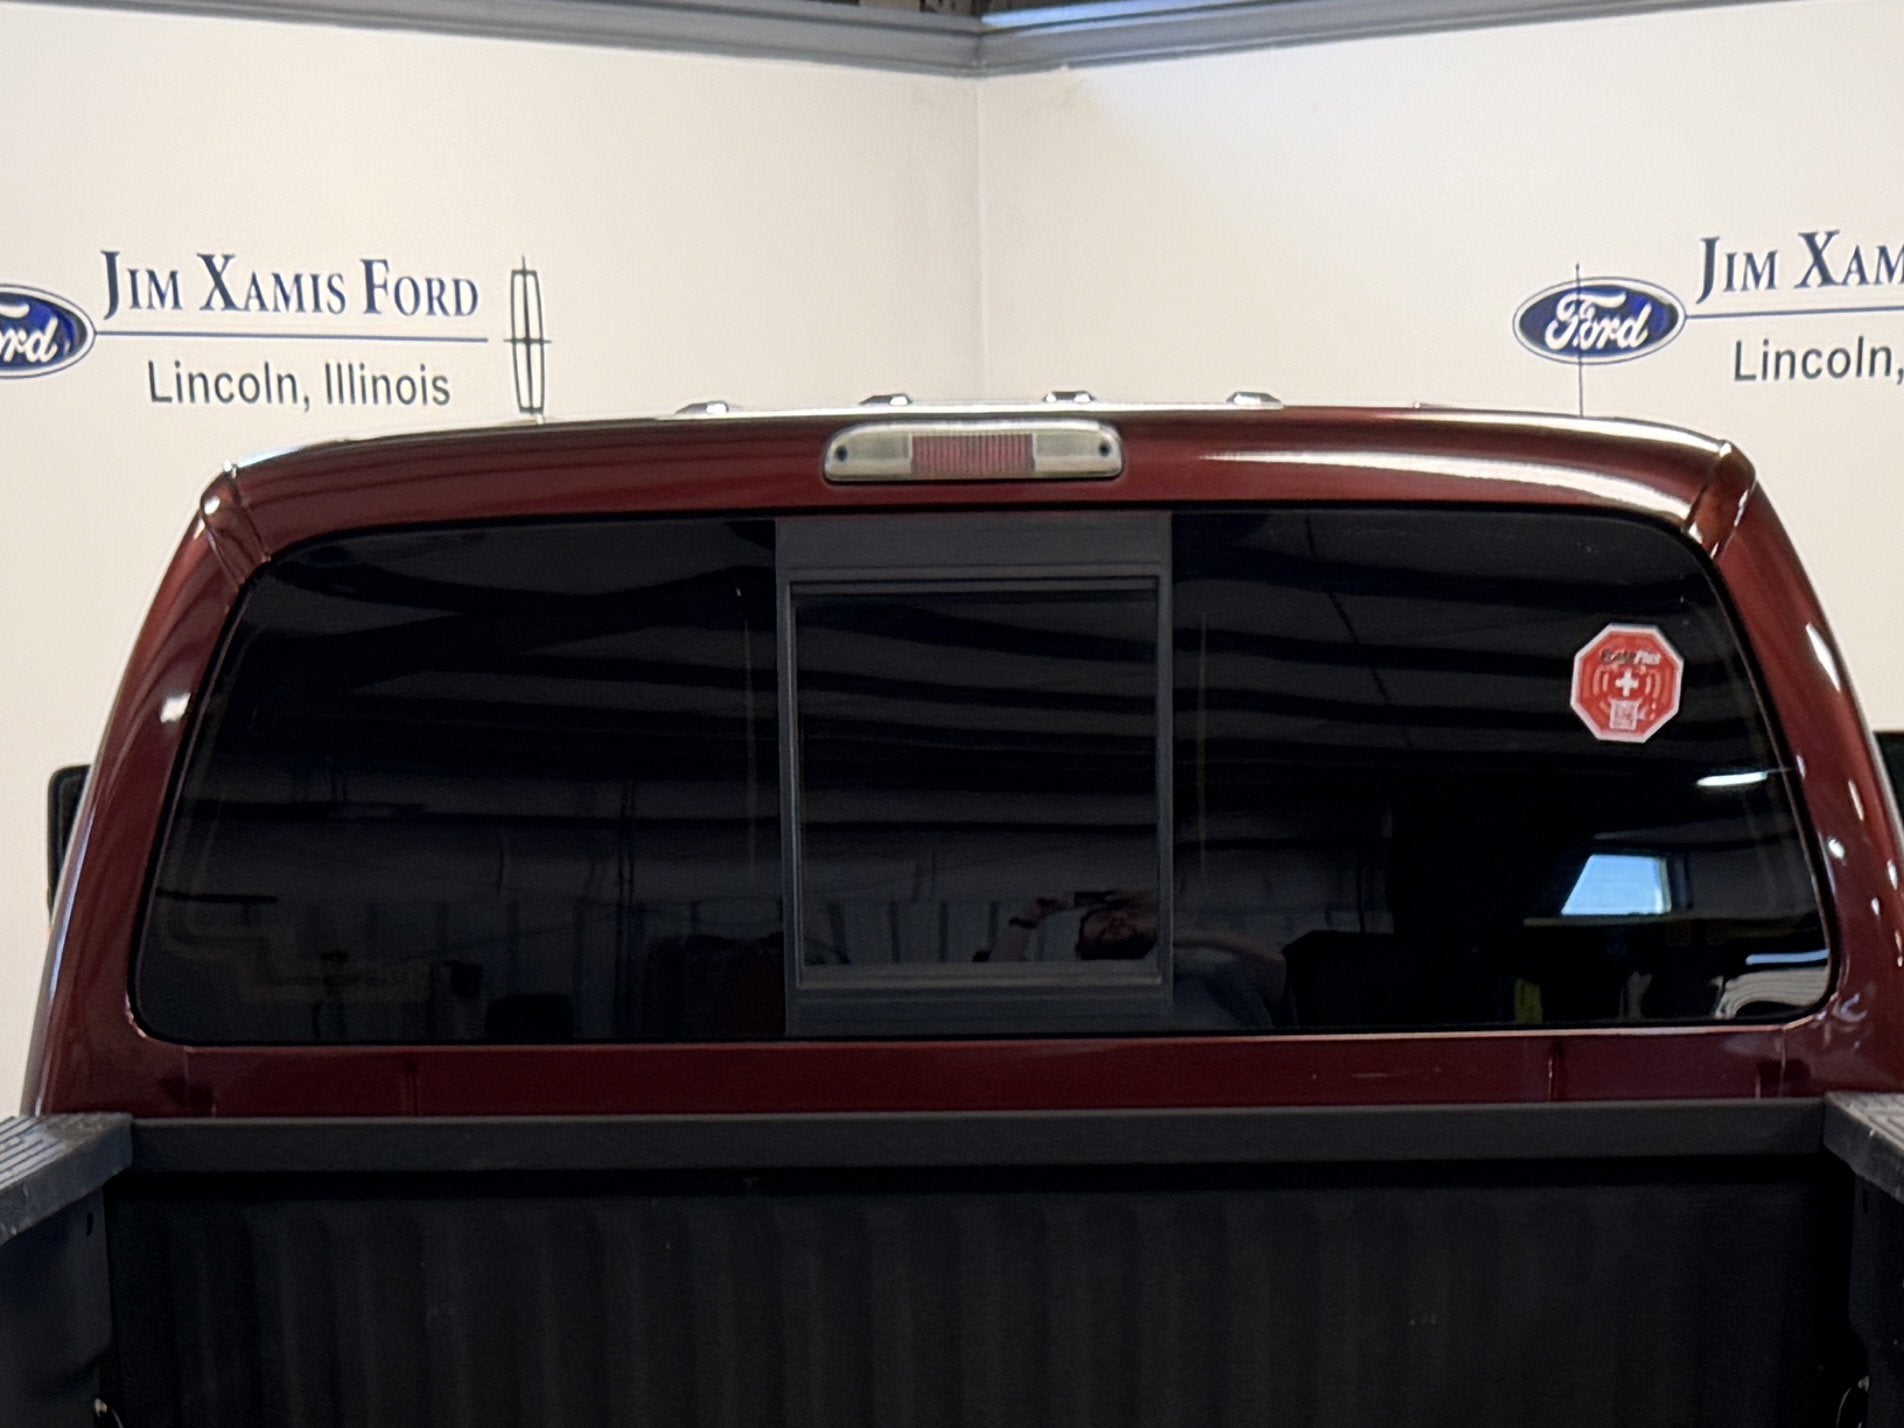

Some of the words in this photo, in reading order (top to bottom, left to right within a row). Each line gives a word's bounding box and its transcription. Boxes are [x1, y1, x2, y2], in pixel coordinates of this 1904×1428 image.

[100, 250, 182, 320] JIM
[196, 252, 346, 315] XAMIS
[360, 258, 479, 317] FORD
[1695, 236, 1778, 305] JIM
[1545, 290, 1649, 350] Ford
[147, 359, 310, 411] Lincoln,
[324, 362, 451, 406] Illinois
[1734, 335, 1904, 384] Lincoln,
